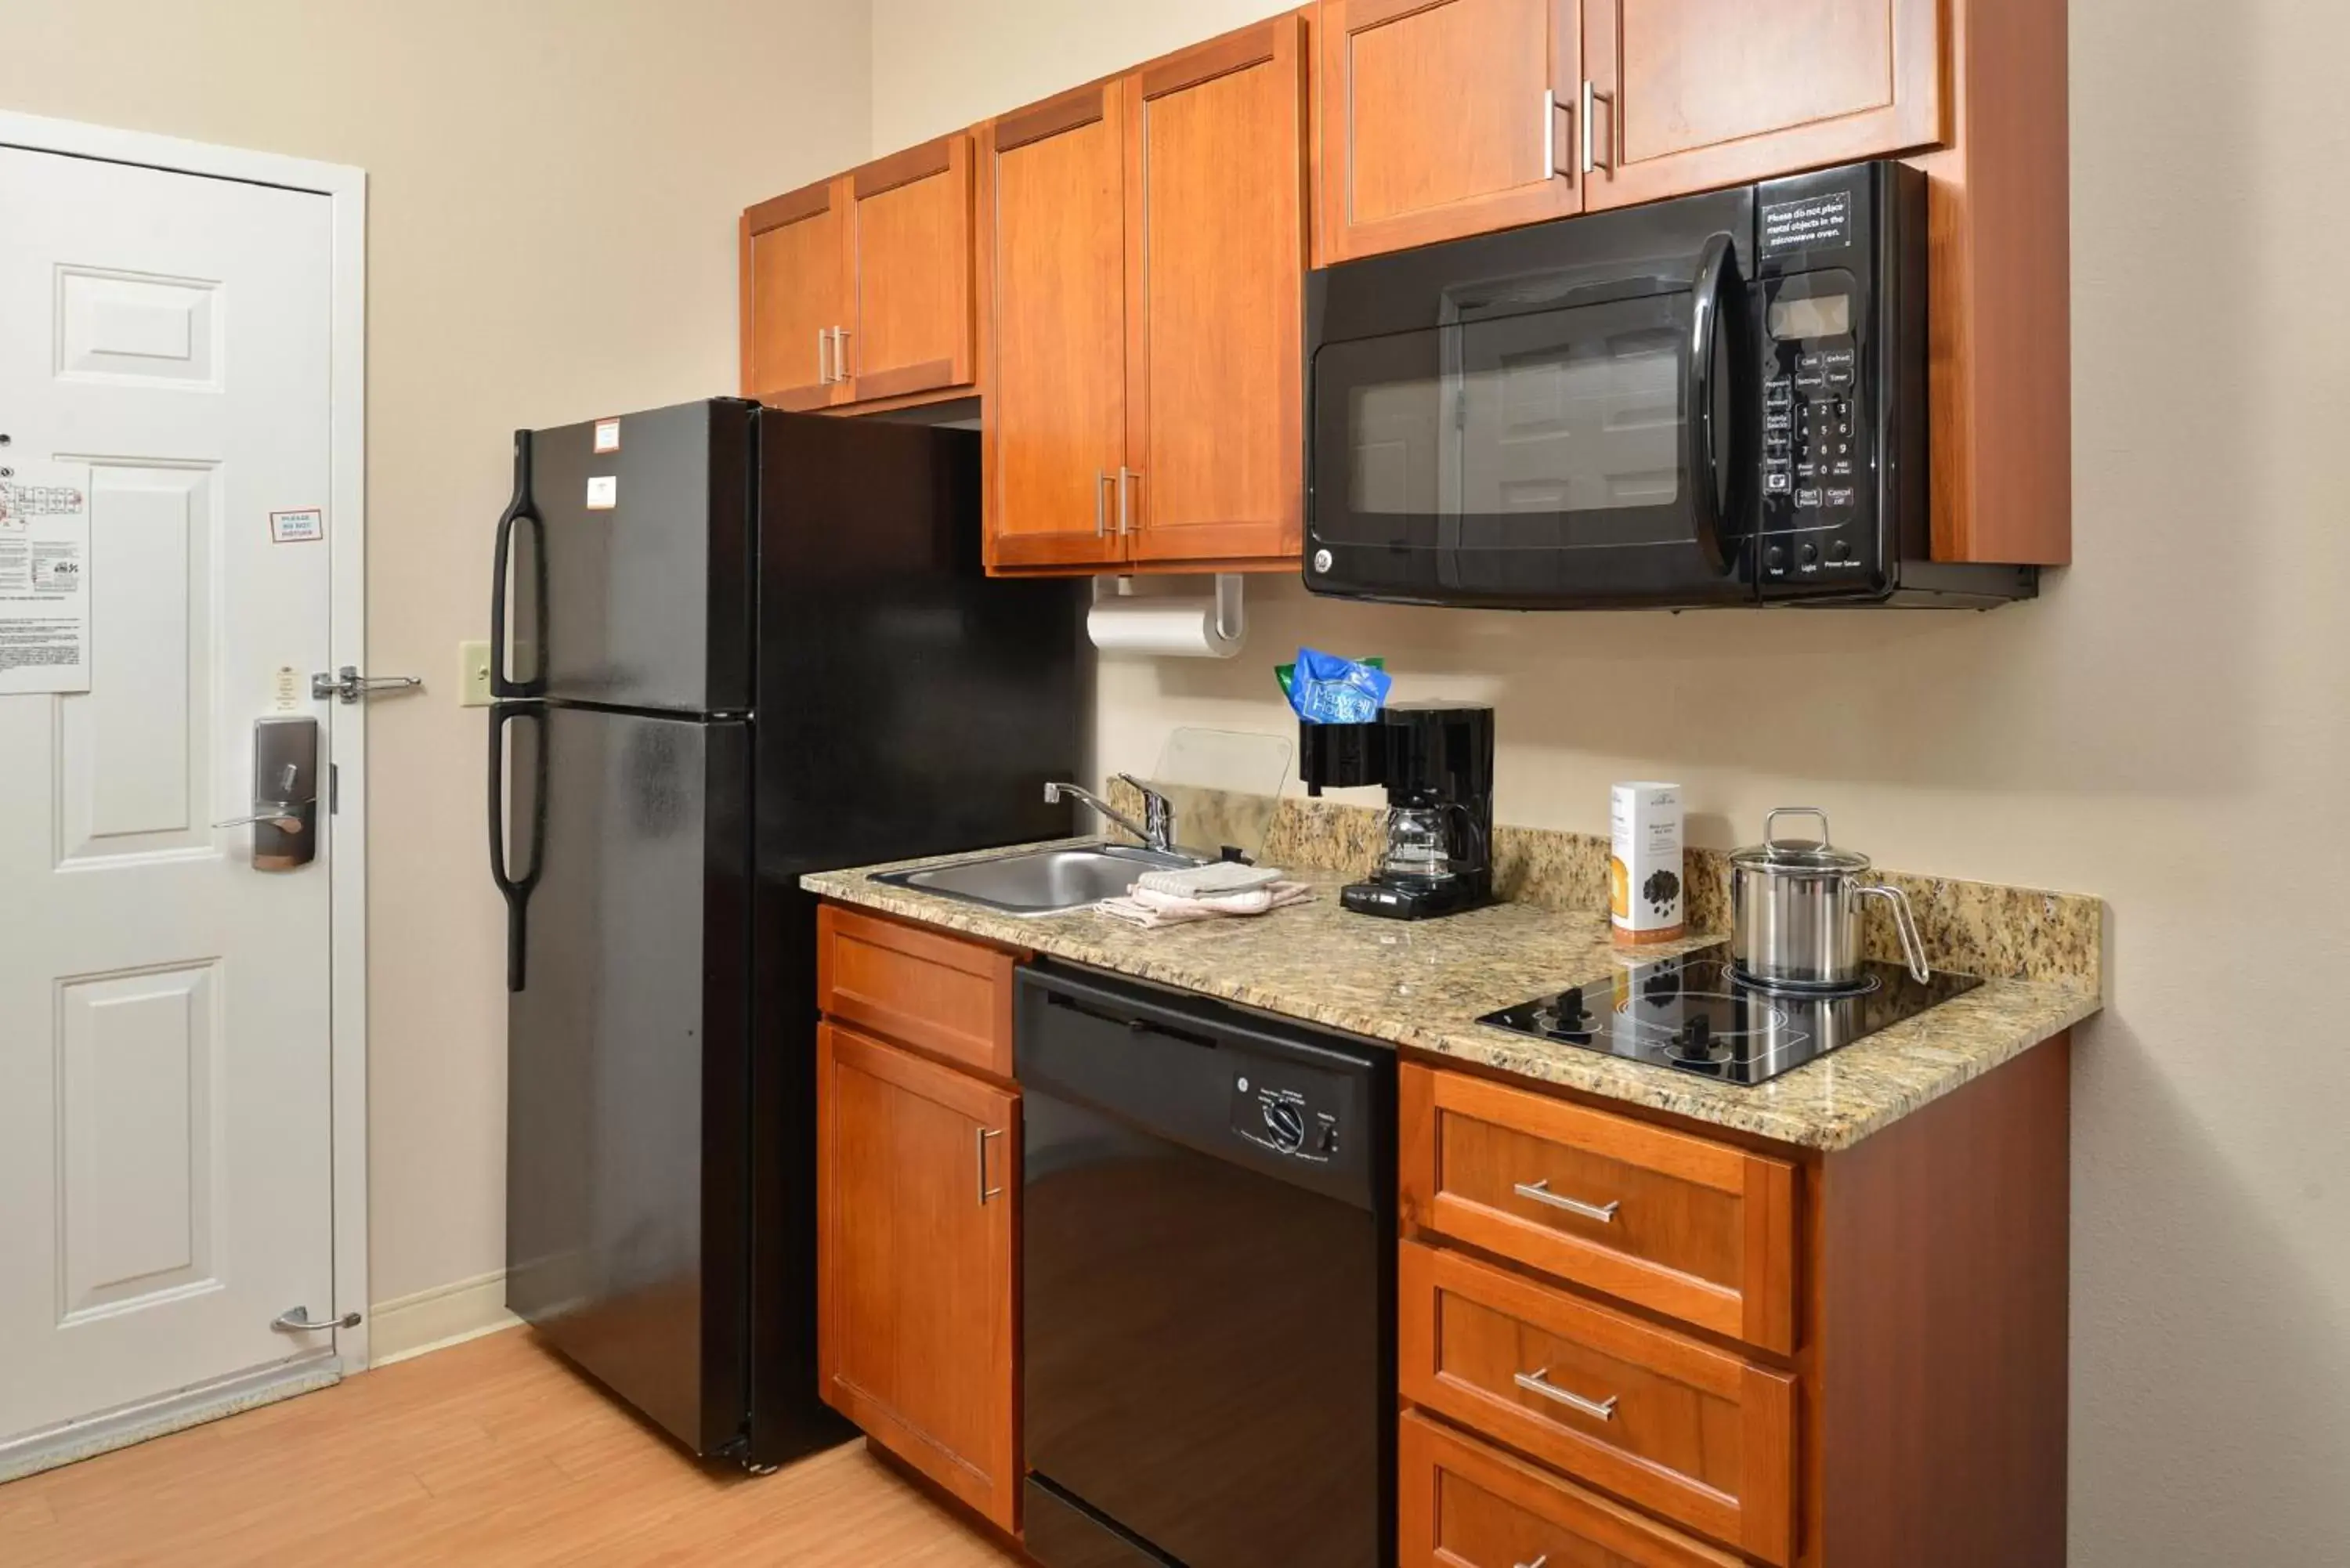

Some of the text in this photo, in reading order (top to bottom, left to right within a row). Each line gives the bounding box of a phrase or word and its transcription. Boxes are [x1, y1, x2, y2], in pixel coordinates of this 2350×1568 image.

[1767, 204, 1843, 222] Please do not place
[1767, 223, 1790, 234] metal
[1791, 220, 1819, 231] objects
[1830, 215, 1845, 224] the
[1770, 229, 1839, 246] microwave oven.
[1802, 403, 1847, 417] 1 2 3
[1802, 423, 1846, 435] 4 5 6
[1802, 446, 1810, 456] 7
[1839, 443, 1846, 453] 9
[1821, 464, 1828, 475] 0
